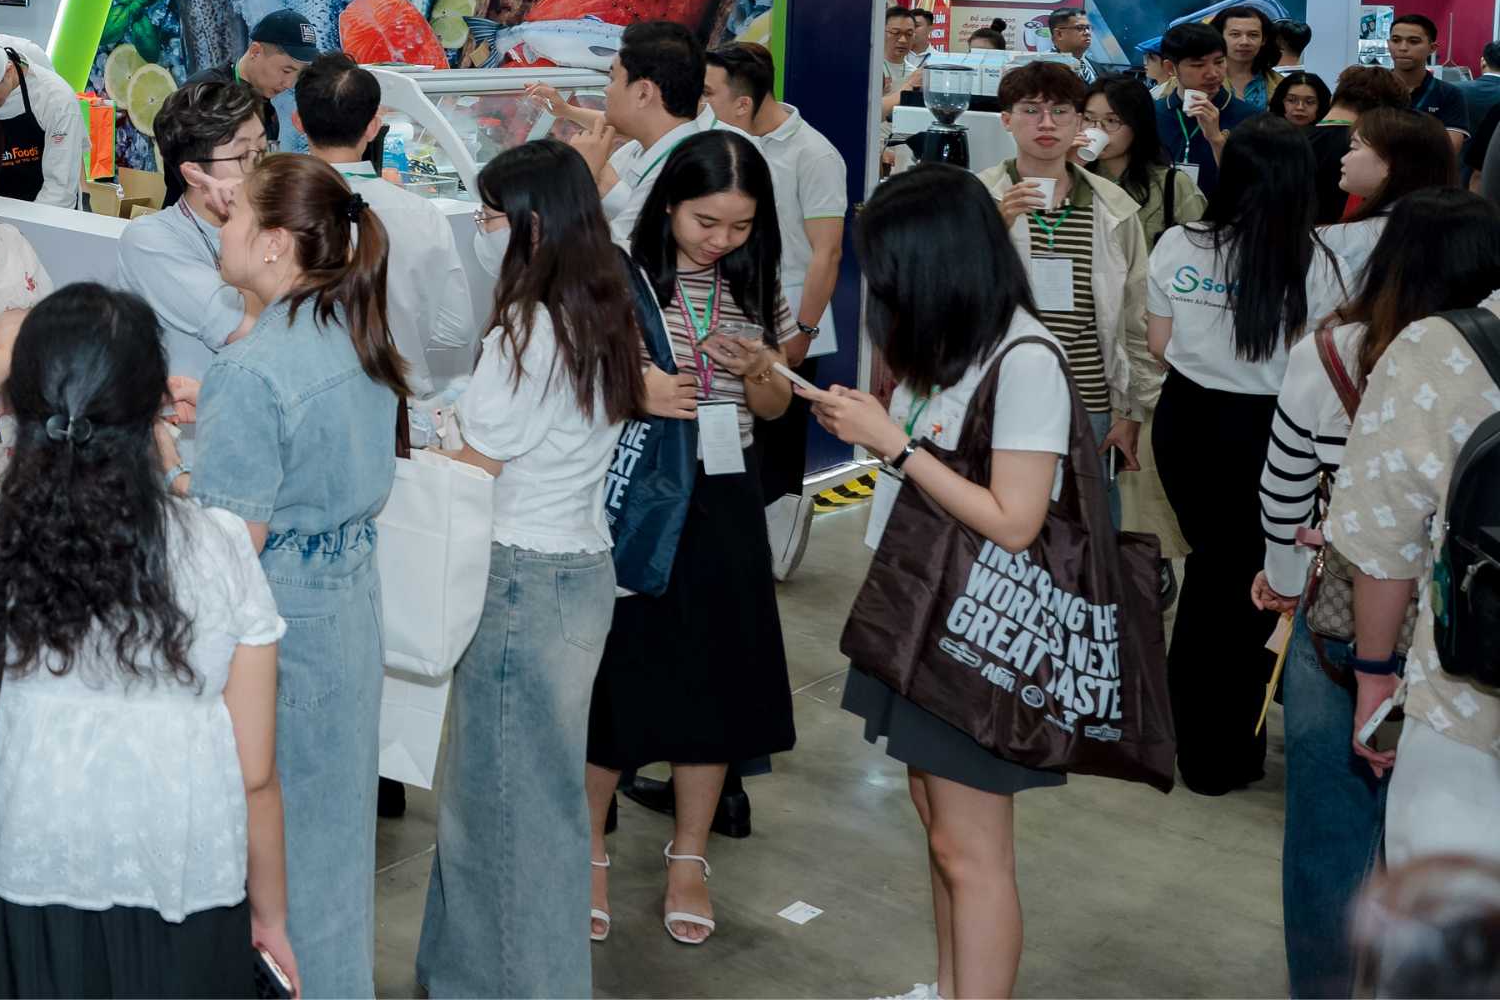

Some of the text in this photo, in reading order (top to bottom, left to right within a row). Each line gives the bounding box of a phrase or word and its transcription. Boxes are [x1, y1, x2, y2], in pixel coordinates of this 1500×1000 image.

[620, 420, 652, 451] HE
[947, 596, 1051, 677] GREAT
[1045, 655, 1123, 720] TASTE
